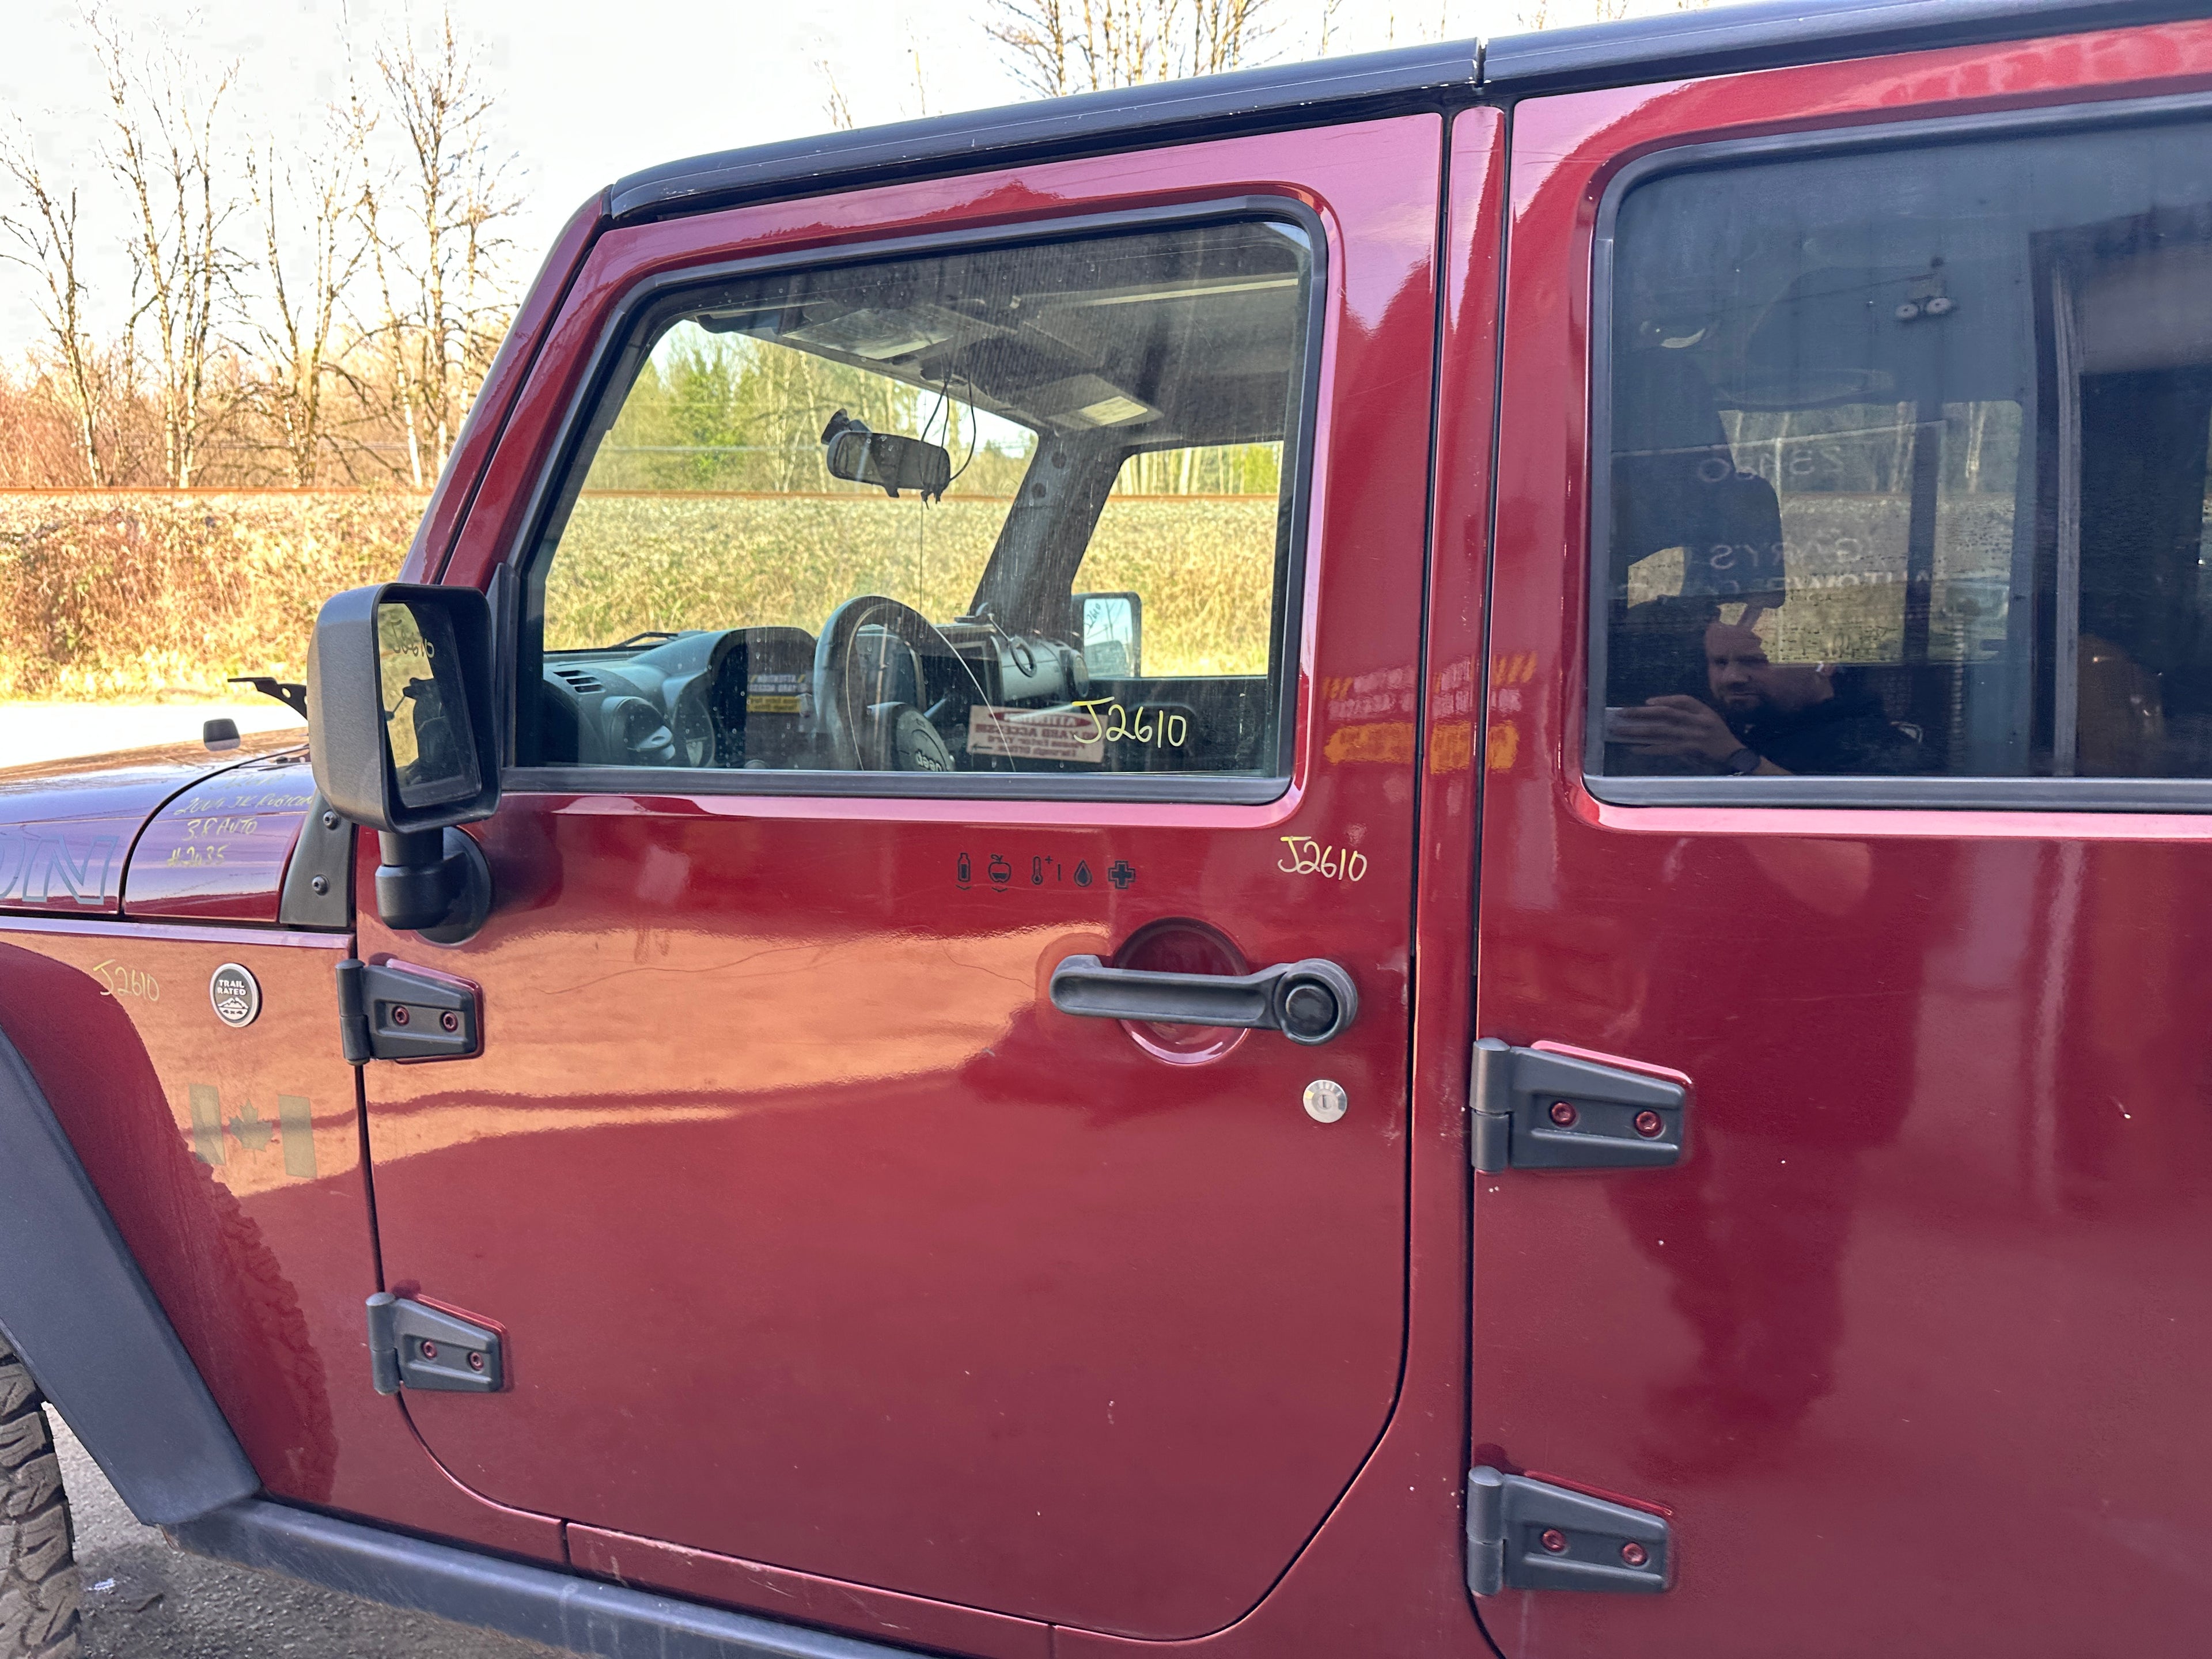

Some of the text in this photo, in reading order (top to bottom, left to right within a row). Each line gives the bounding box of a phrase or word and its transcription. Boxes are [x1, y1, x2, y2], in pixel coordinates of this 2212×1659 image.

[1071, 696, 1187, 748] J2610
[1278, 836, 1368, 881] J2610
[93, 959, 160, 1001] J2610
[217, 987, 247, 996] RATED
[218, 979, 245, 988] TRAIL
